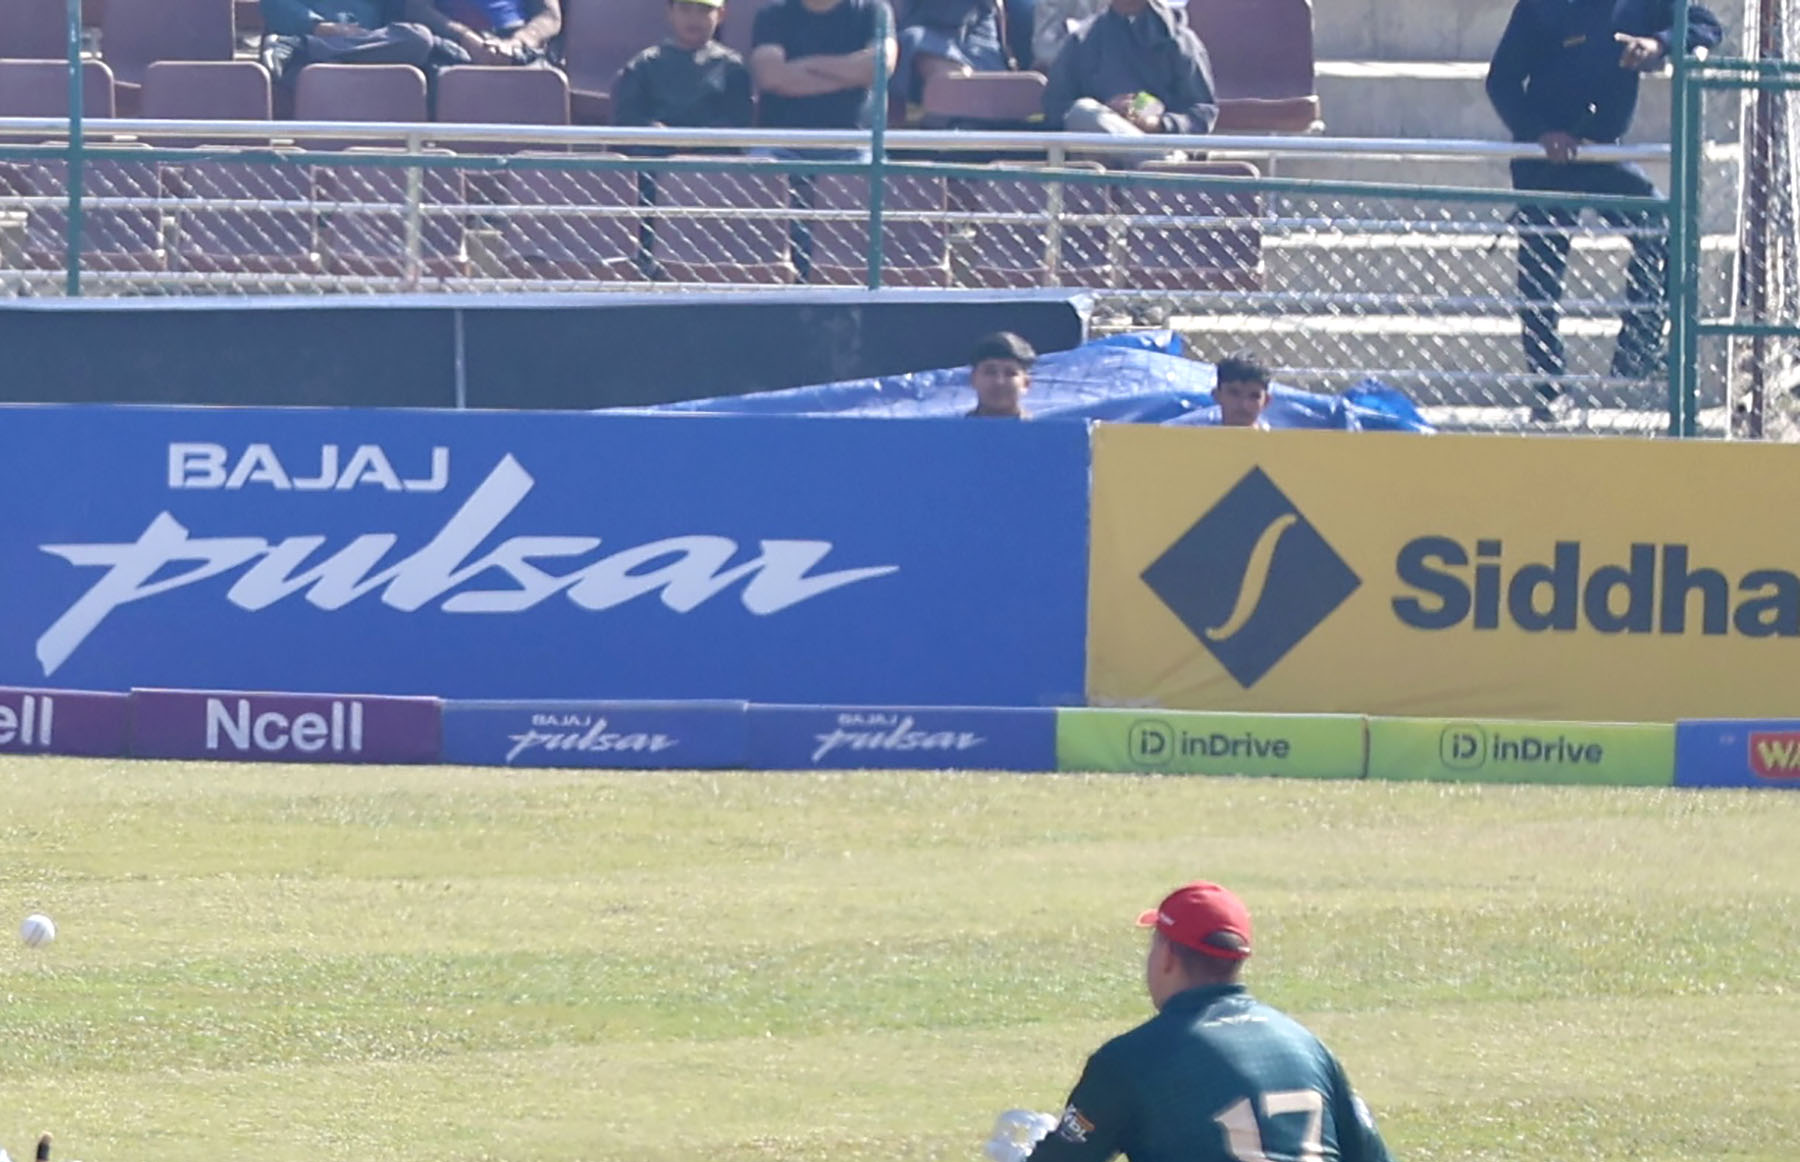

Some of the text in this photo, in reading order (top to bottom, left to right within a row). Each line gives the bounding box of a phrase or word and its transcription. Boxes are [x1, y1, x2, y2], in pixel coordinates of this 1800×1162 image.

[168, 442, 449, 492] BAJAJ
[36, 453, 899, 677] pulsar
[1391, 535, 1800, 639] Siddha
[205, 699, 363, 752] Ncell
[505, 718, 680, 762] pulsar
[531, 713, 593, 727] BAJAJ
[812, 716, 987, 763] pulsar
[837, 712, 898, 726] BAJAJ
[1181, 731, 1291, 760] inDrive
[1492, 735, 1604, 764] inDrive
